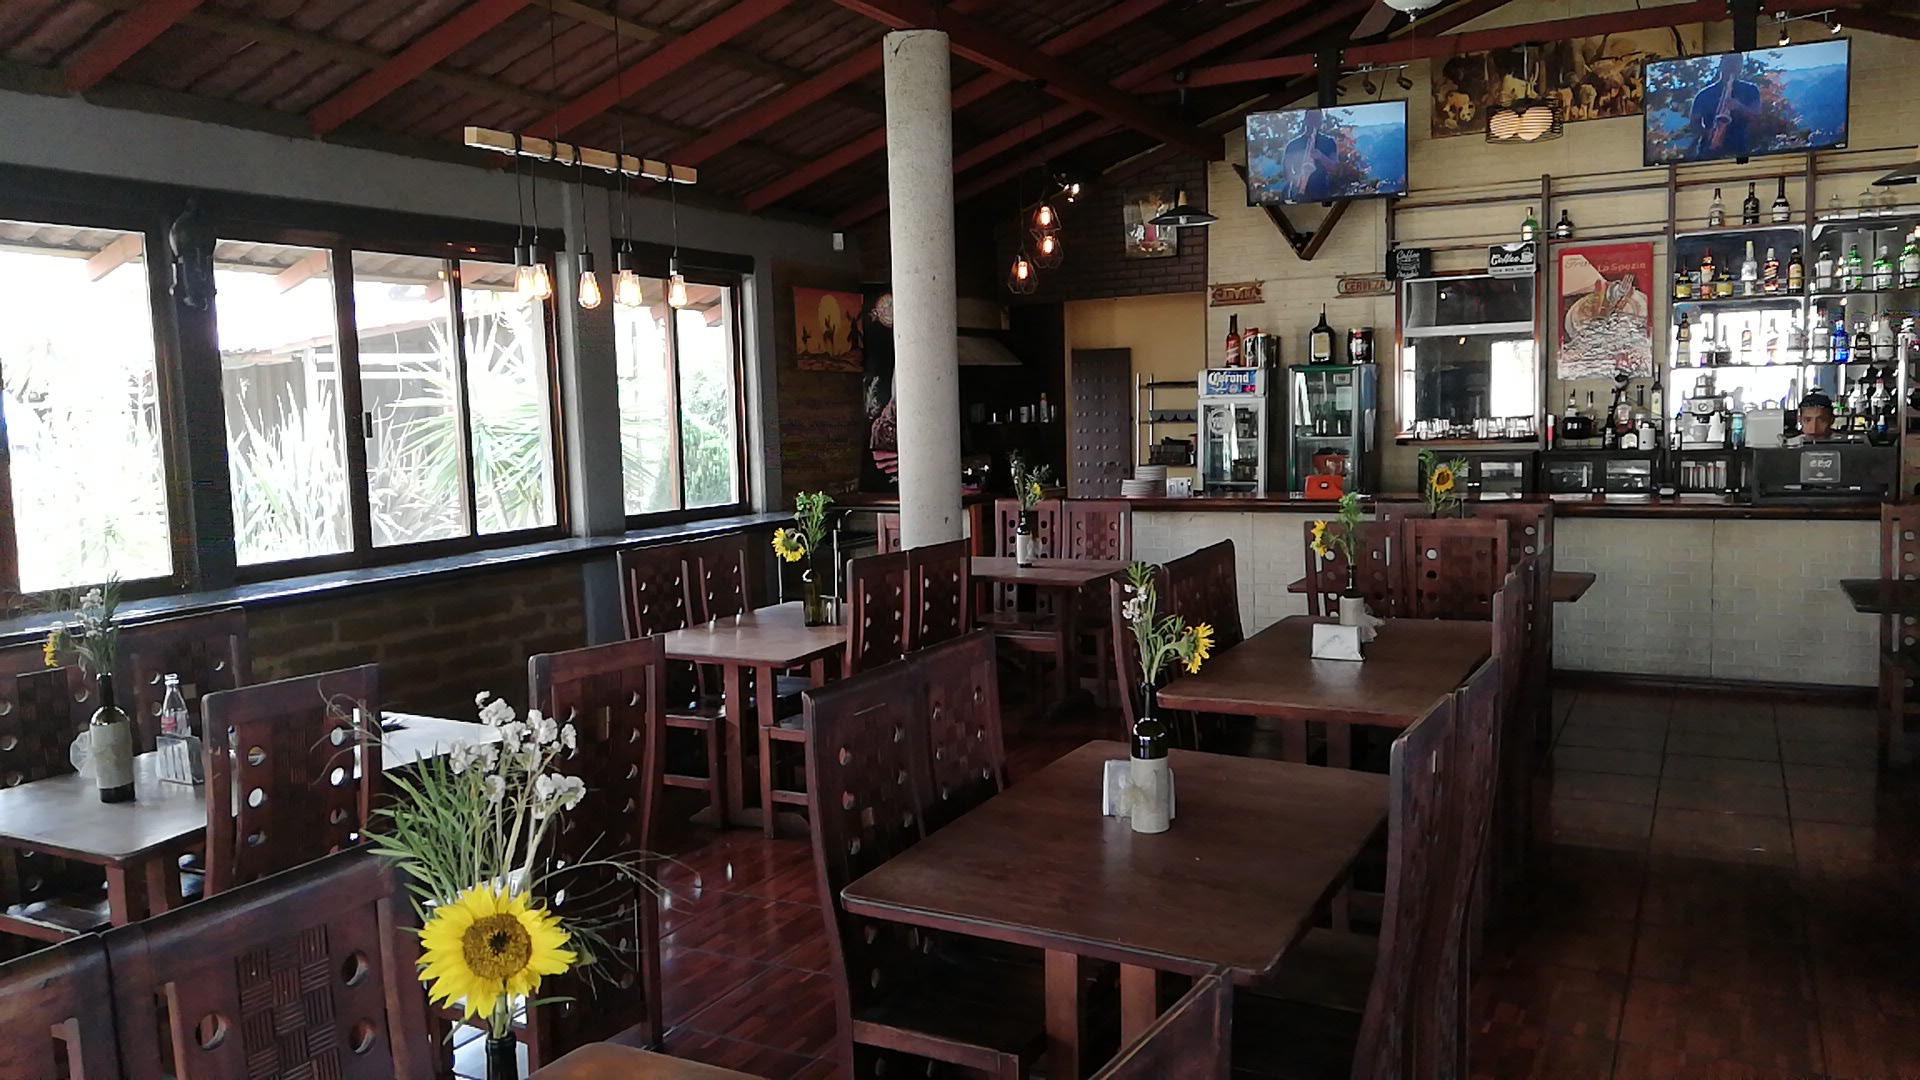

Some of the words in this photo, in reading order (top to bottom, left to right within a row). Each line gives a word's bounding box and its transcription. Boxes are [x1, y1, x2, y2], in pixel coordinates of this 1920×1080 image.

[1396, 250, 1420, 261] Coffee
[1491, 253, 1520, 265] Coffee
[1611, 262, 1646, 271] Spezia
[1344, 279, 1386, 291] CERVEZA
[1208, 371, 1250, 386] Corona
